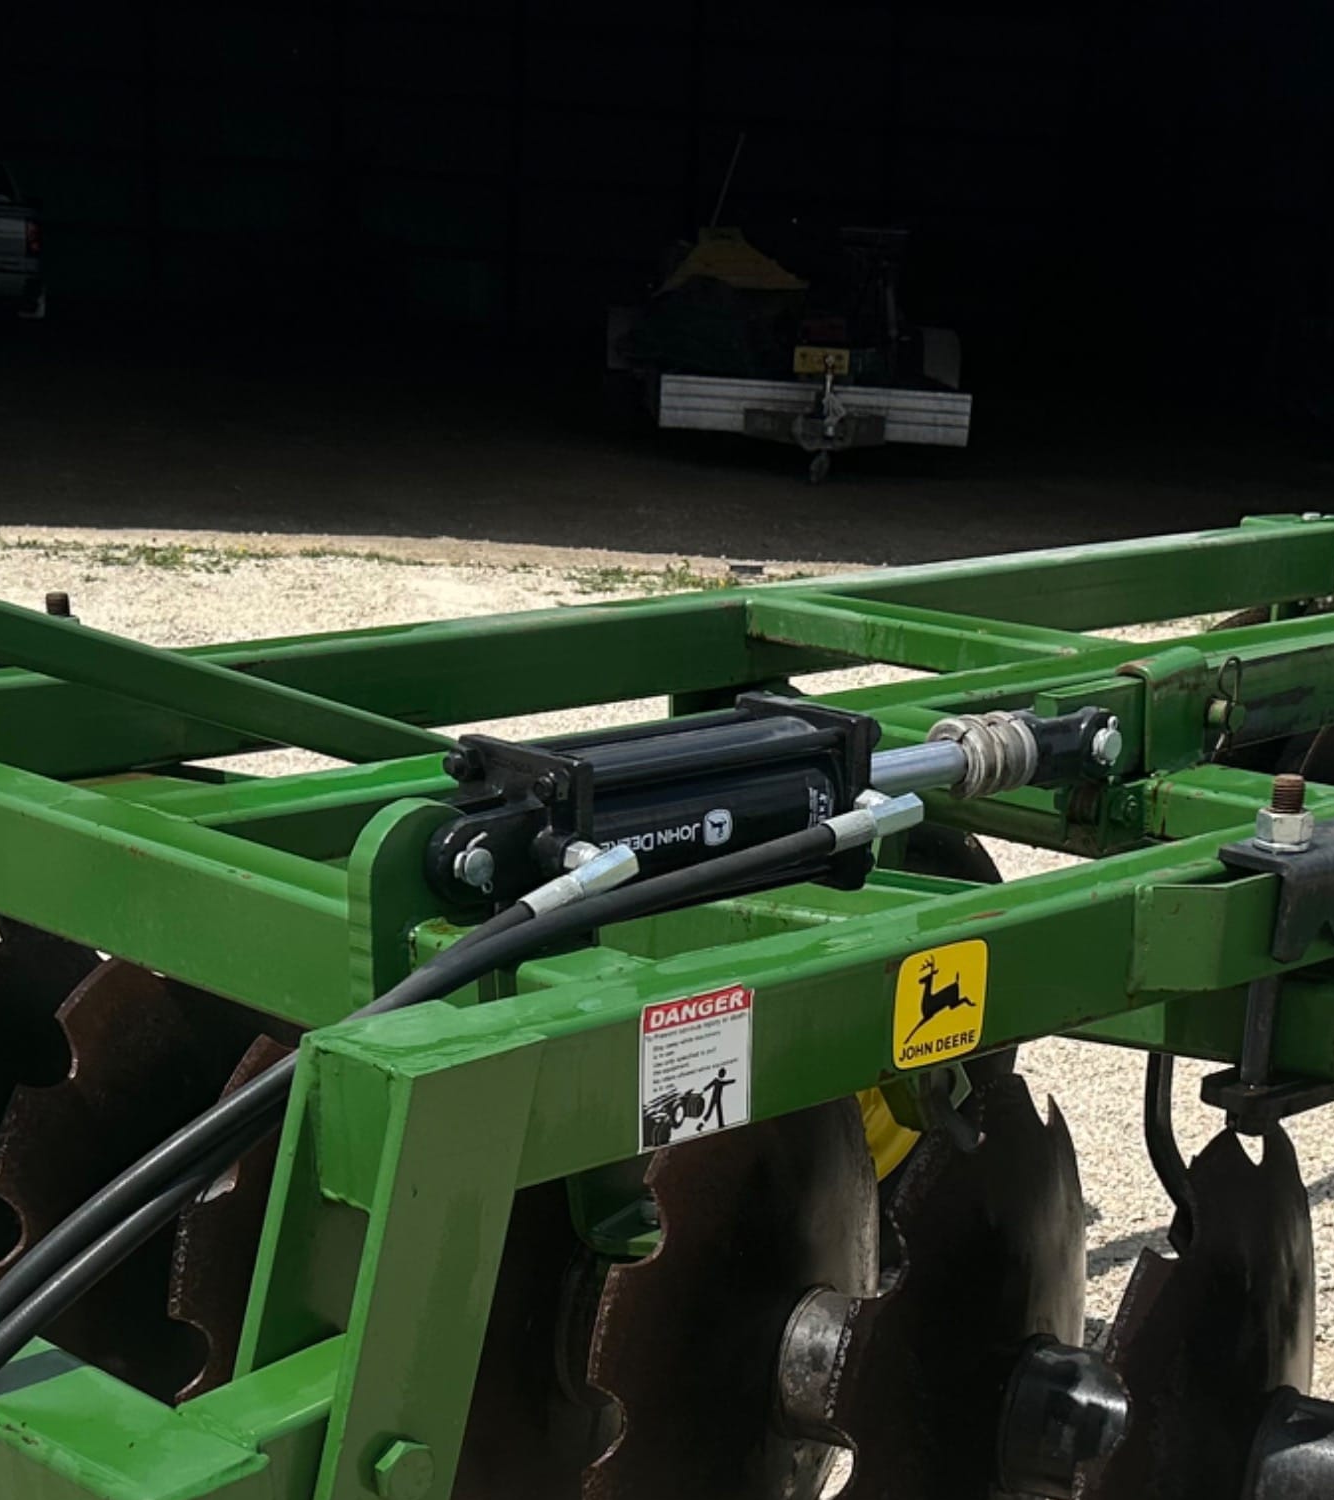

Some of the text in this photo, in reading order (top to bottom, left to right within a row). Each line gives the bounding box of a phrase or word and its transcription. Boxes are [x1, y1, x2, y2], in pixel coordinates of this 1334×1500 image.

[656, 822, 701, 846] JOHN
[649, 990, 744, 1029] DANGER
[899, 1029, 976, 1062] JOHN DEERE
